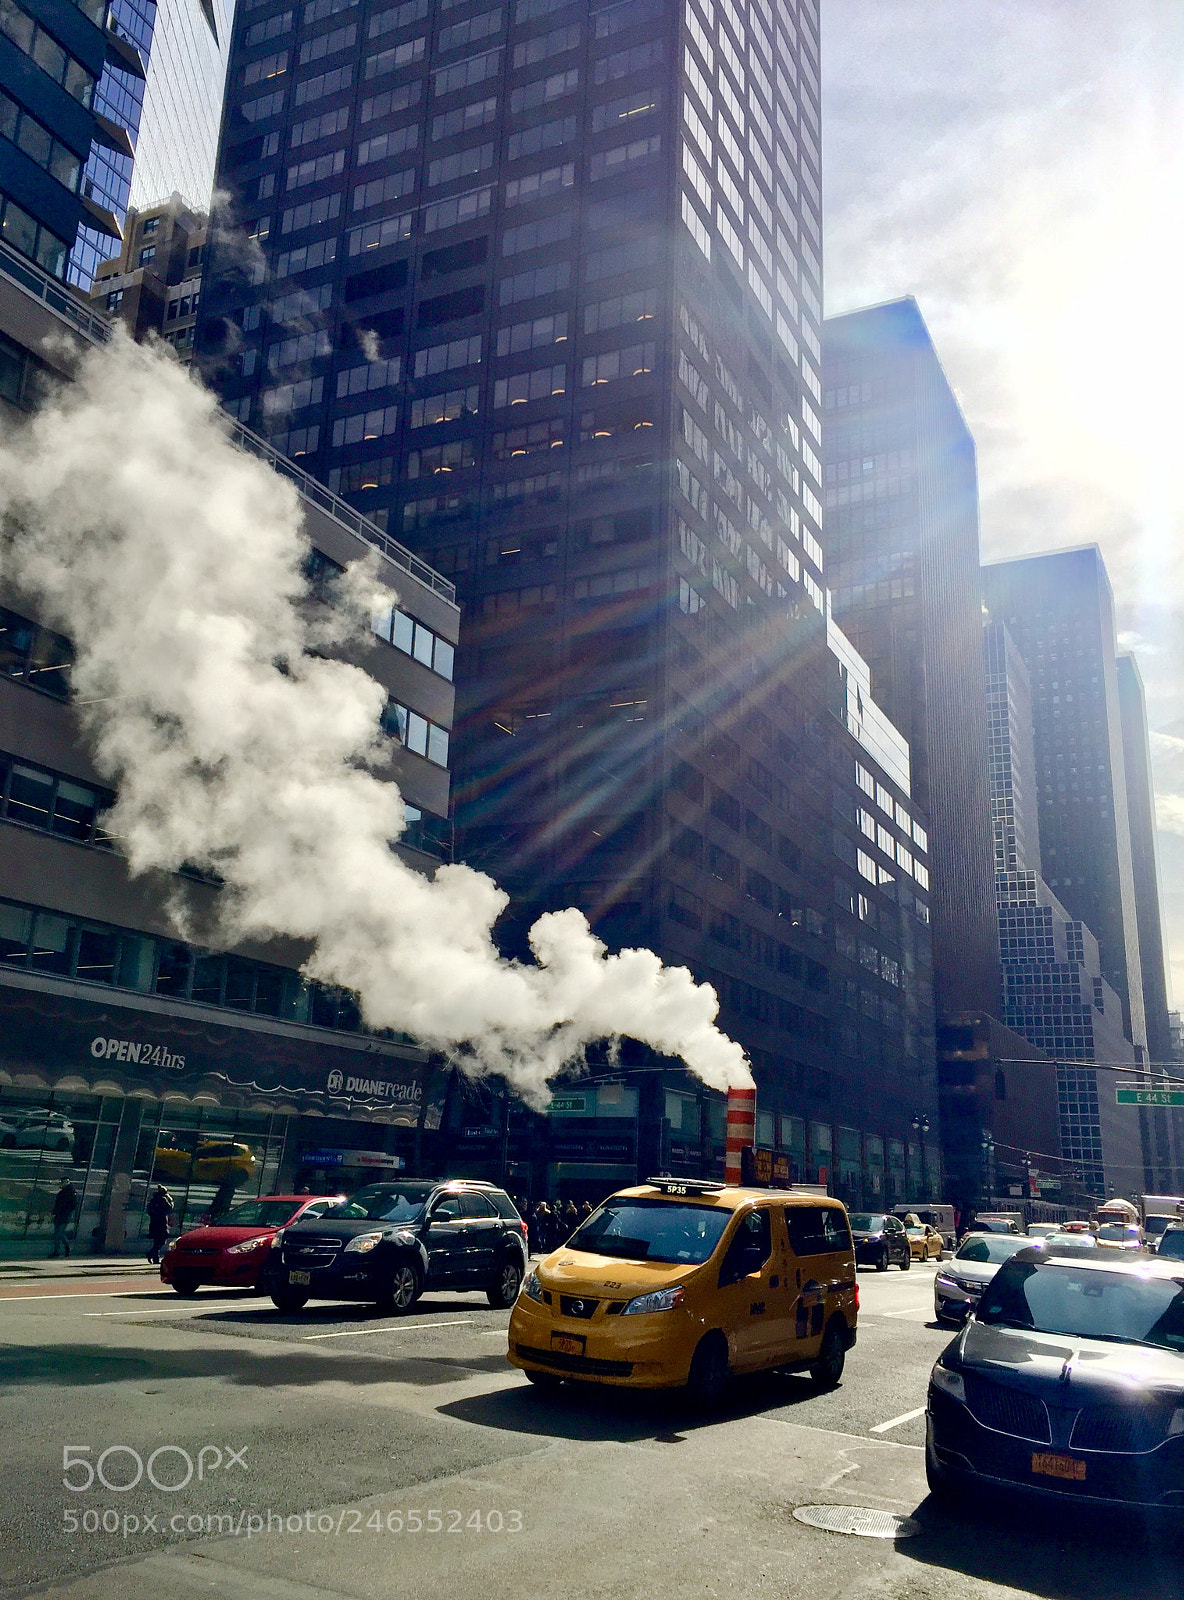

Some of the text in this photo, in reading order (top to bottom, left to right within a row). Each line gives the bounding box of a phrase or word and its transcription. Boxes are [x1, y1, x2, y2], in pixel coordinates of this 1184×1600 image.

[1136, 1092, 1171, 1103] E 44 St
[566, 1100, 573, 1109] St
[667, 1185, 687, 1195] 5P35
